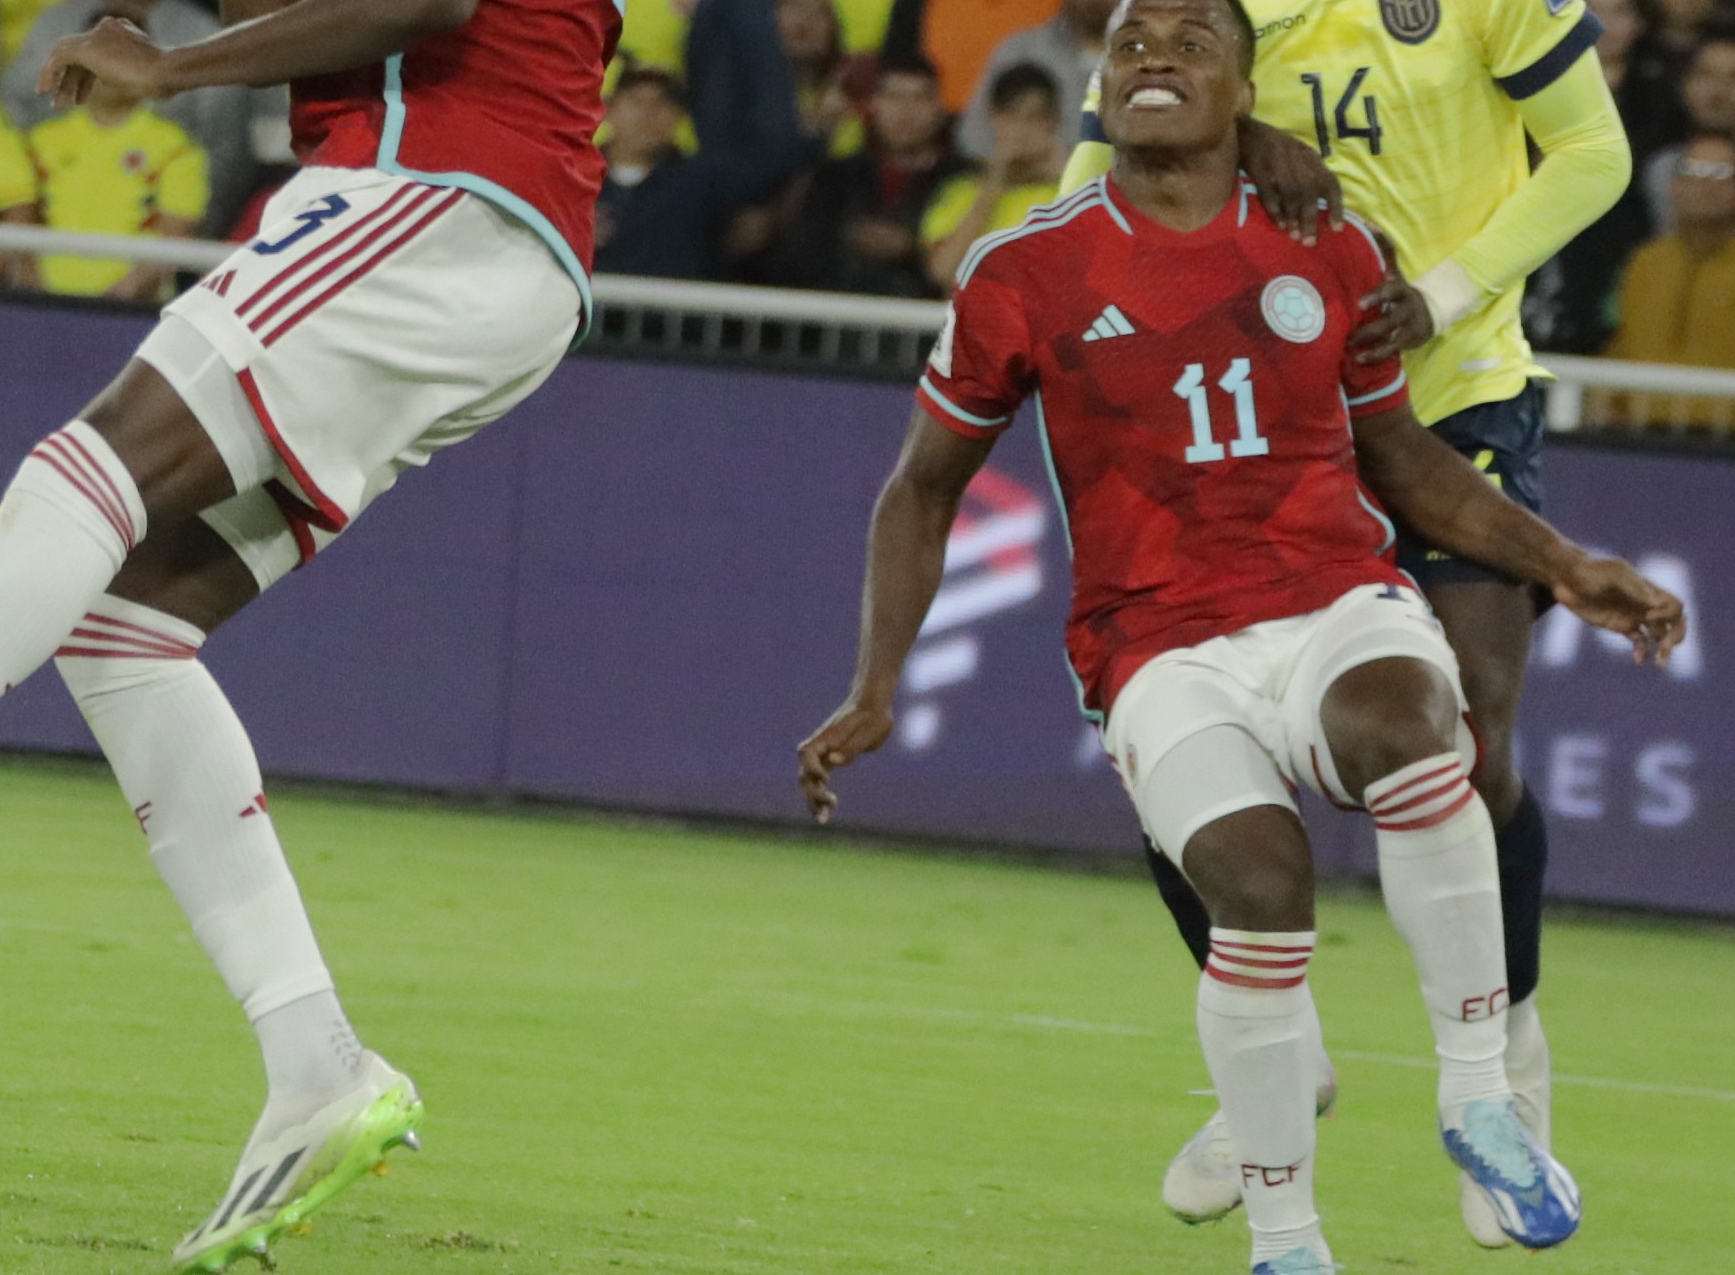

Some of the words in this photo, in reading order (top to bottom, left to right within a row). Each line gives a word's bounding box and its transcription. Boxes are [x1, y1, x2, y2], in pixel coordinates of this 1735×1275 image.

[1254, 13, 1306, 39] athon
[1301, 66, 1383, 158] 14
[252, 193, 351, 255] 3
[1172, 357, 1269, 463] 11
[1461, 987, 1510, 1023] FC
